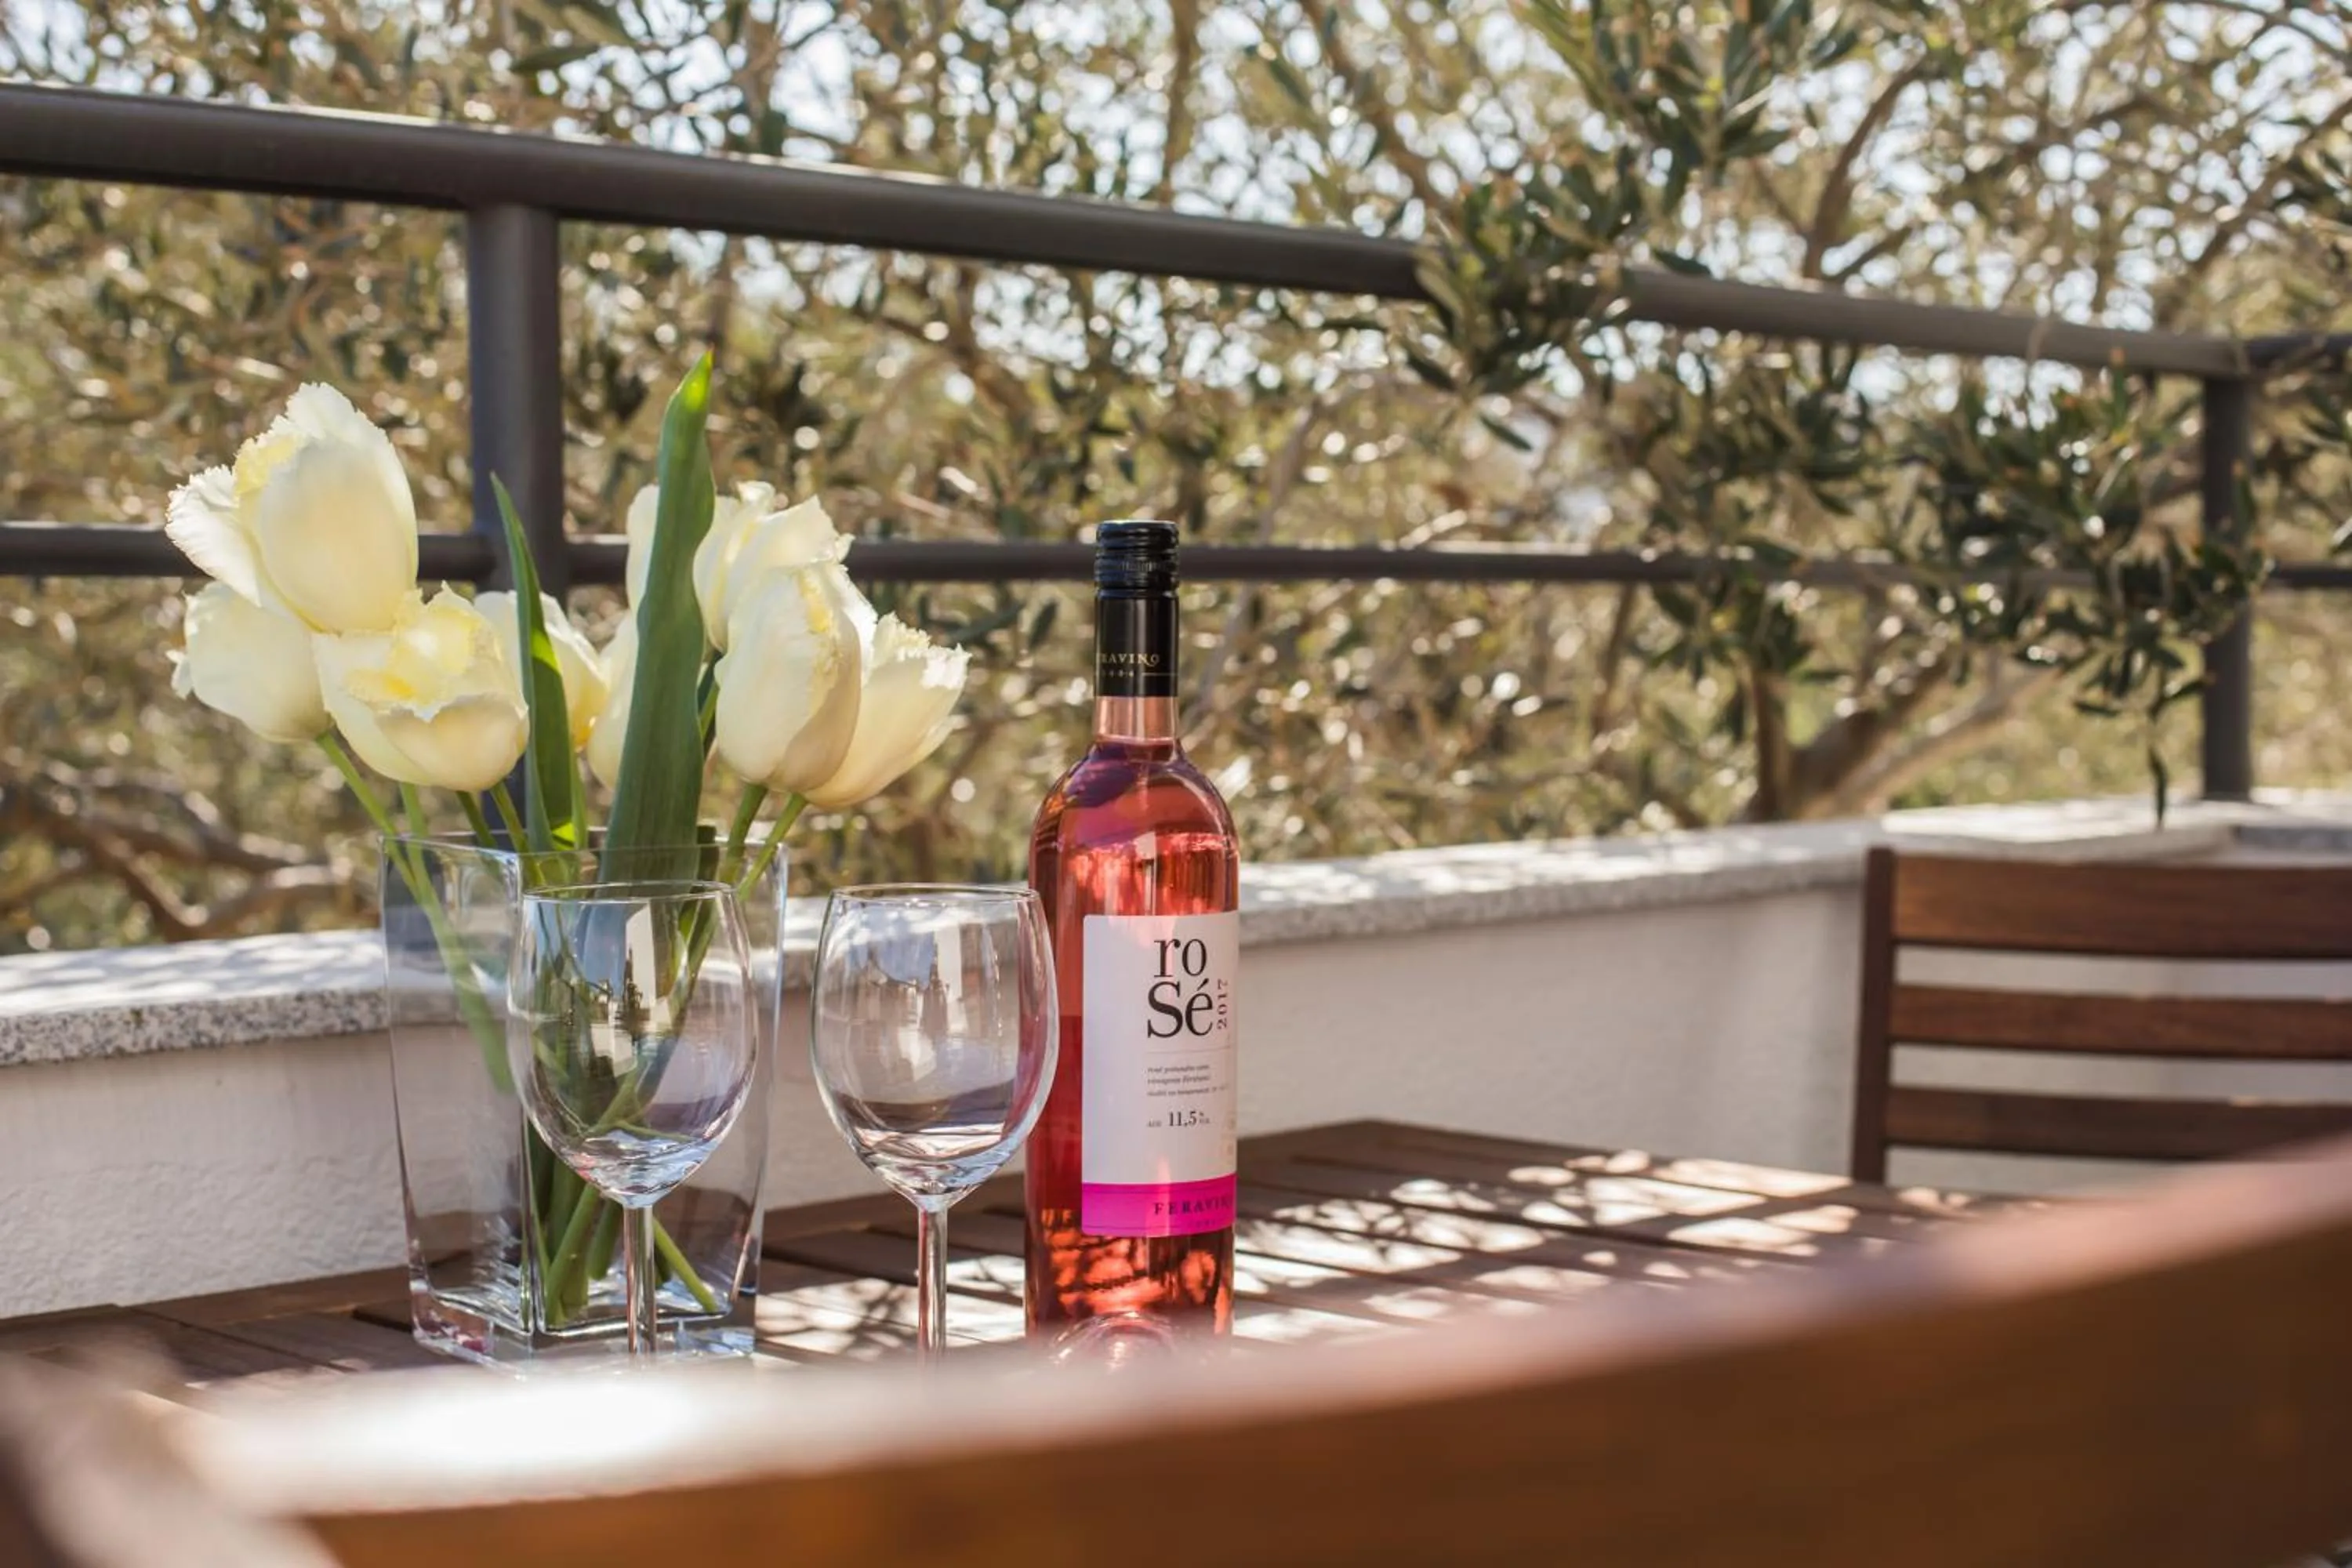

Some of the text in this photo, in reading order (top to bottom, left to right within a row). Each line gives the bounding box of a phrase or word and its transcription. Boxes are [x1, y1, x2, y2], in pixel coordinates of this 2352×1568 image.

[1099, 653, 1160, 667] RAVINO
[1154, 938, 1207, 978] ro
[1147, 978, 1214, 1039] Sé
[1217, 978, 1229, 1030] 2017
[1153, 1194, 1233, 1215] FERAVIN
